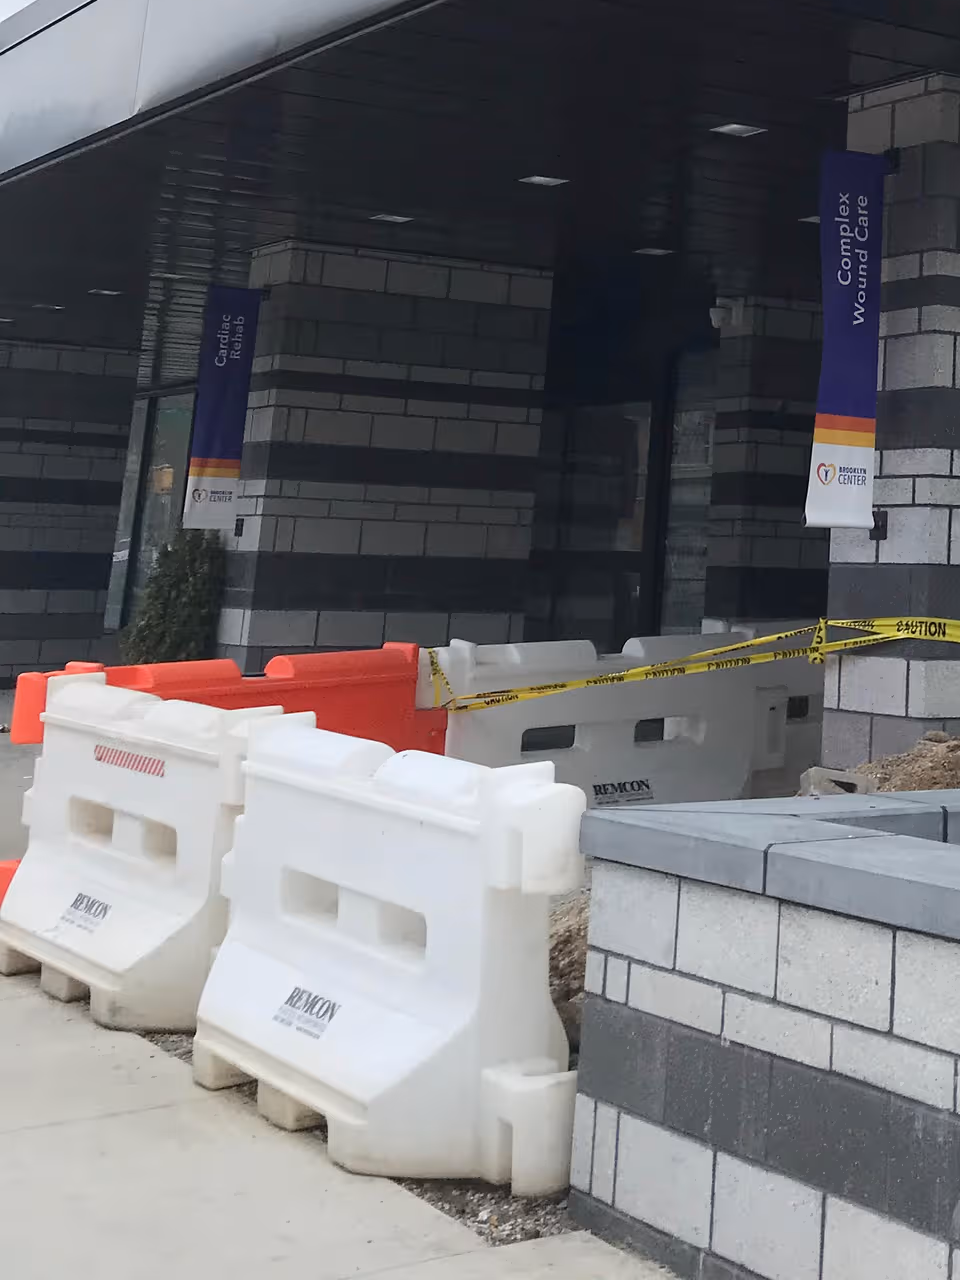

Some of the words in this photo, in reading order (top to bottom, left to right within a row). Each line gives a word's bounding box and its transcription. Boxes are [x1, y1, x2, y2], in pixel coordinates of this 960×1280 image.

[854, 195, 869, 242] Care
[835, 192, 854, 286] Complex
[852, 249, 868, 325] Wound
[214, 314, 231, 367] Cardiac
[229, 316, 245, 359] Rehab
[838, 474, 867, 486] CENTER
[839, 466, 867, 475] BROOKLYN
[209, 495, 233, 503] CENTER
[896, 621, 946, 638] CAUTION
[593, 779, 650, 796] REMCON
[70, 892, 112, 921] REMCON
[284, 986, 342, 1024] REMCON
